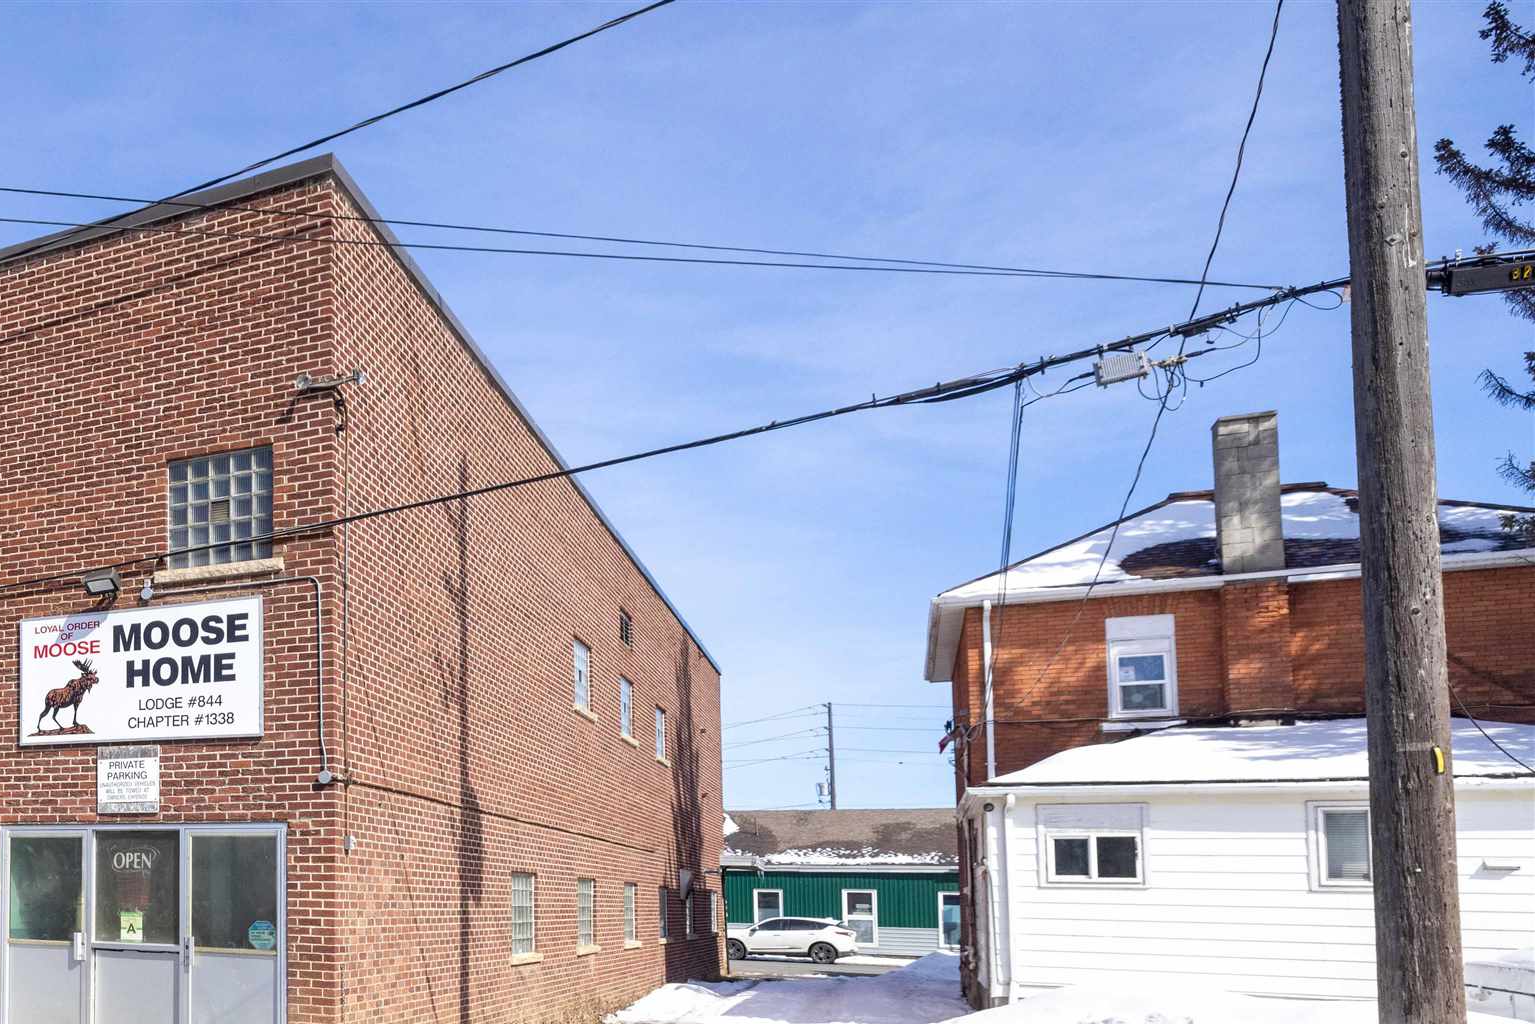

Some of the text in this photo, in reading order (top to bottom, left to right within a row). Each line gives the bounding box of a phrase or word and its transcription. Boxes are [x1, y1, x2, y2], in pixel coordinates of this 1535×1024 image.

[34, 620, 100, 634] LOYAL ORDER
[112, 612, 249, 653] MOOSE
[60, 632, 73, 640] OF
[33, 640, 101, 659] MOOSE
[125, 652, 236, 688] HOME
[138, 694, 223, 711] LODGE #844
[127, 711, 235, 729] CHAPTER #1338
[108, 760, 145, 770] PRIVATE
[106, 770, 148, 780] PARKING
[113, 852, 152, 869] OPEN
[126, 923, 137, 934] A
